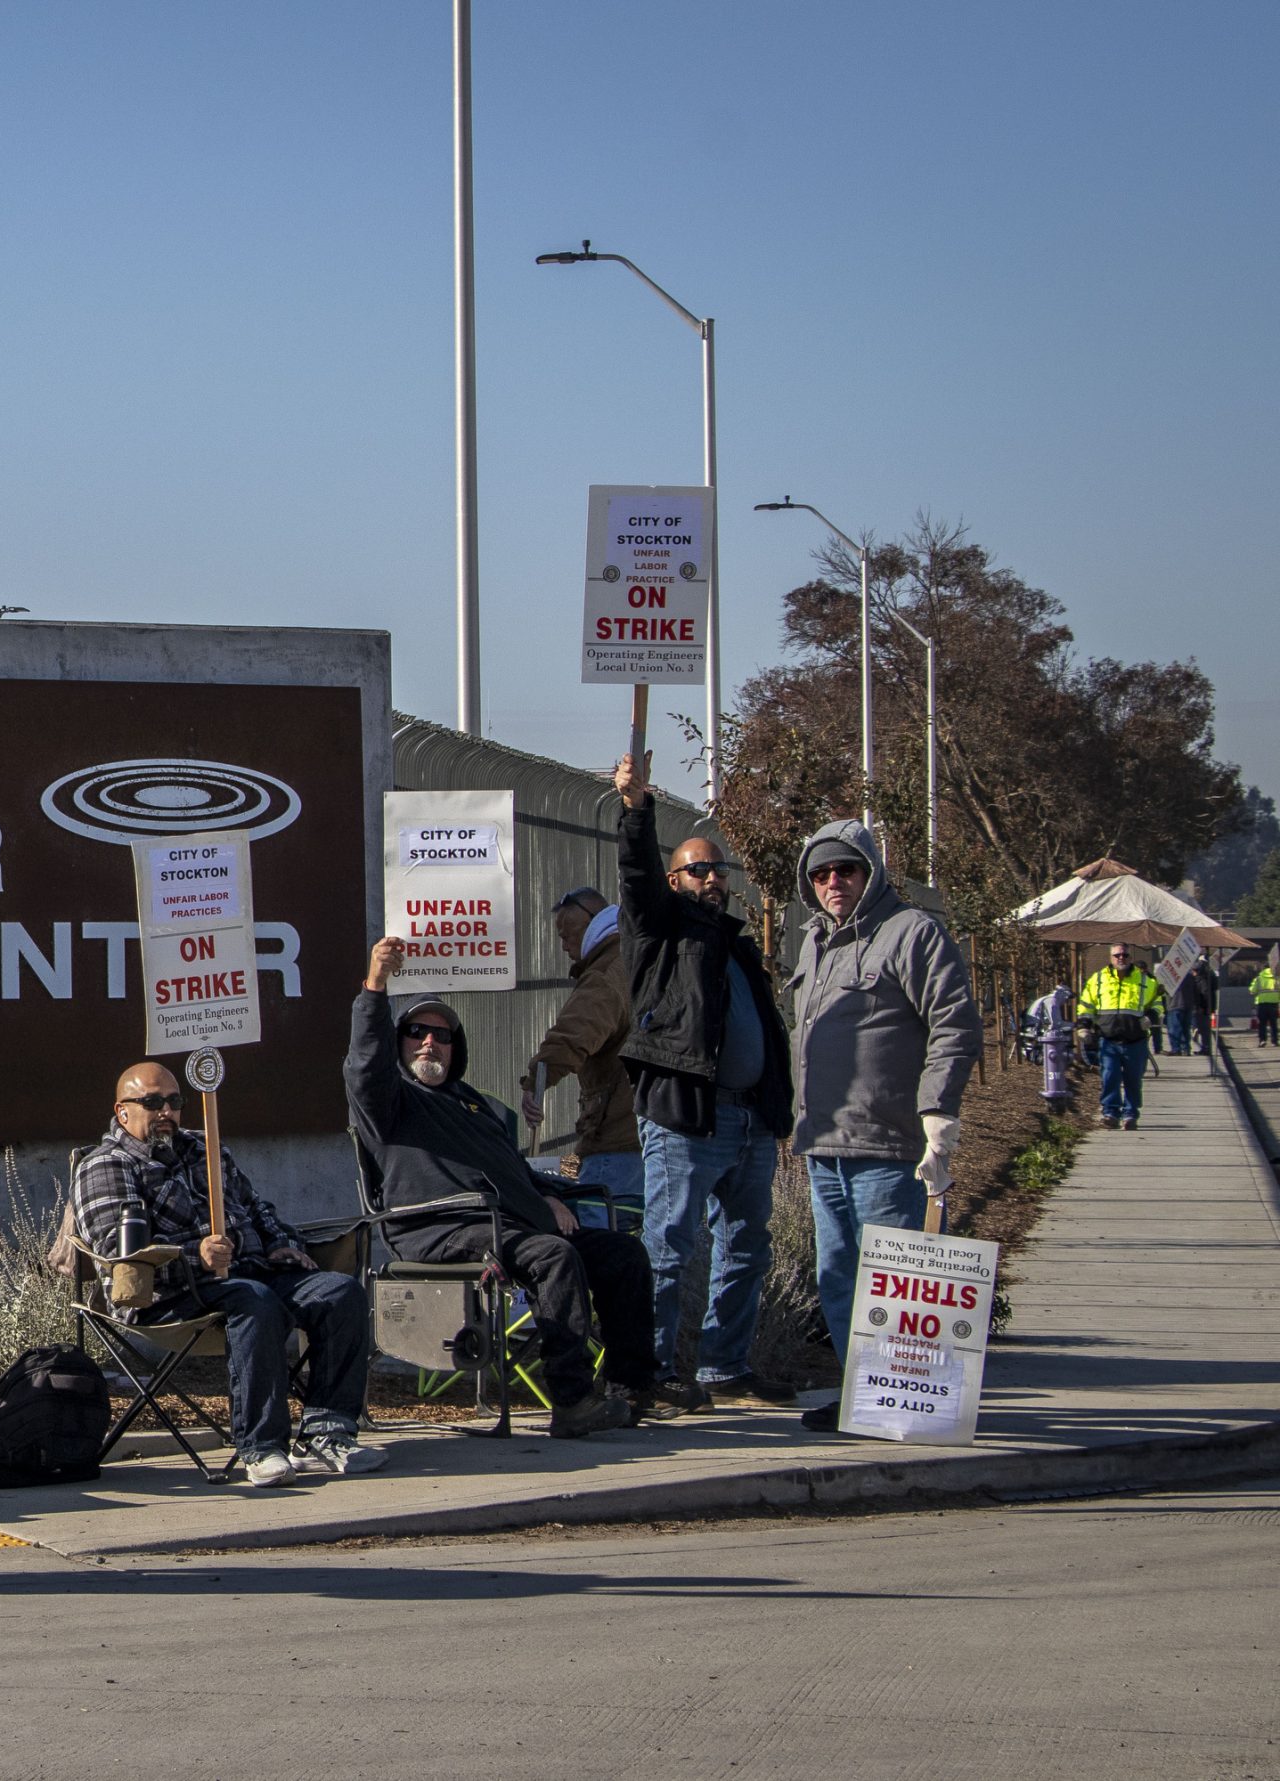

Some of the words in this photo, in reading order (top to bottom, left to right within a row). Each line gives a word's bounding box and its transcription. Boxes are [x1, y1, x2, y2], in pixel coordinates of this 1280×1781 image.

[628, 516, 660, 527] CITY
[664, 517, 682, 527] OF
[617, 535, 692, 545] STOCKTON
[633, 549, 671, 558] UNFAIR
[634, 562, 668, 570] LABOR
[626, 575, 675, 584] PRACTICE
[627, 585, 666, 609] ON
[596, 617, 695, 641] STRIKE
[586, 649, 645, 661] Operating
[647, 650, 704, 662] Engineers
[596, 661, 627, 673] Local
[630, 662, 664, 673] Union
[666, 663, 685, 673] No.
[687, 664, 694, 673] 3
[420, 830, 453, 841] CITY
[458, 829, 477, 840] OF
[169, 850, 198, 862] CITY
[201, 848, 218, 859] OF
[410, 848, 487, 859] STOCKTON
[160, 867, 228, 882] STOCKTON
[162, 894, 198, 905] UNFAIR
[199, 892, 229, 902] LABOR
[171, 907, 222, 918] PRACTICES
[406, 900, 492, 916] UNFAIR
[410, 921, 488, 937] LABOR
[180, 935, 215, 963] ON
[155, 970, 247, 1005] STRIKE
[157, 1009, 203, 1026] Operating
[204, 1006, 249, 1021] Engineers
[165, 1024, 190, 1039] Local
[191, 1023, 219, 1036] Union
[221, 1020, 236, 1033] No.
[237, 1019, 243, 1030] 3
[874, 1239, 881, 1248] 3
[885, 1240, 905, 1252] No.
[908, 1243, 945, 1259] Union
[949, 1247, 982, 1263] Local
[863, 1250, 924, 1269] Engineers
[928, 1258, 990, 1278] Operating
[870, 1272, 978, 1310] STRIKE
[898, 1311, 941, 1339] ON
[887, 1335, 940, 1350] PRACTICE
[894, 1350, 930, 1363] LABOR
[890, 1363, 930, 1377] UNFAIR
[868, 1374, 949, 1396] STOCKTON
[876, 1396, 896, 1408] OF
[900, 1401, 935, 1414] CITY
